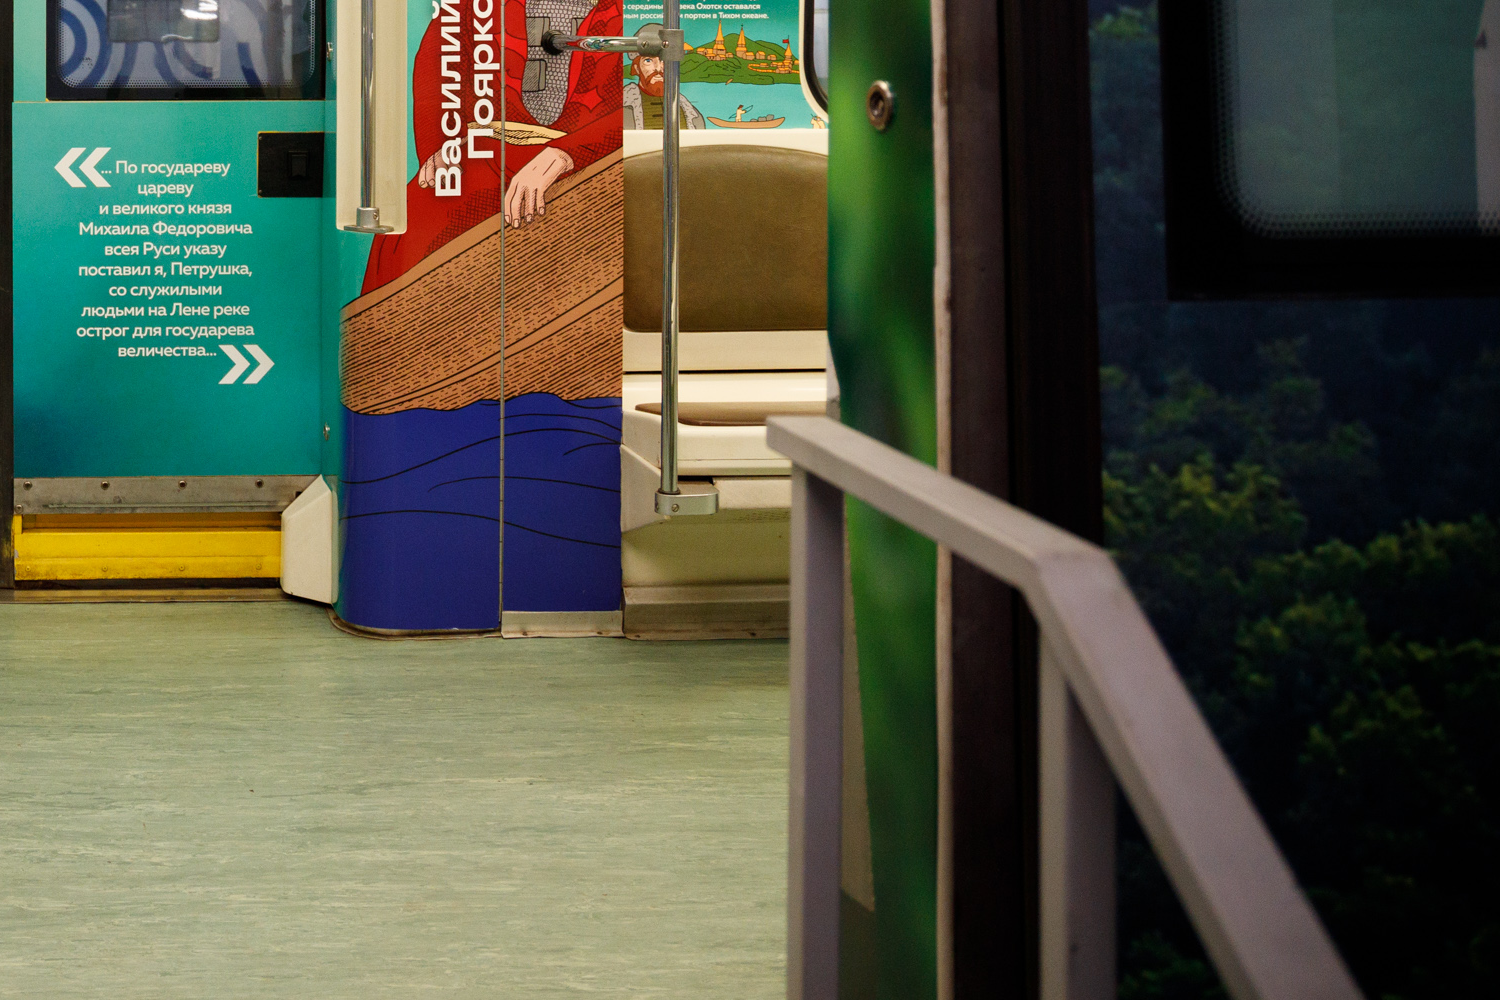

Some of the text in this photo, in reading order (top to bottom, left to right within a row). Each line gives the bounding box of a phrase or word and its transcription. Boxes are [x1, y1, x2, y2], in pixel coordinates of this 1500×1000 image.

[116, 160, 231, 178] По государеву
[138, 184, 194, 197] цареву
[99, 203, 232, 215] и великого князя
[79, 221, 253, 238] Михаила Федоровича
[104, 241, 227, 259] всея Руси указу
[78, 262, 253, 279] поставил я, Петрушка,
[108, 285, 222, 300] со служилыми
[81, 302, 250, 319] людьми на Лене реке
[76, 325, 255, 340] острог для государева
[118, 346, 217, 357] величества...
